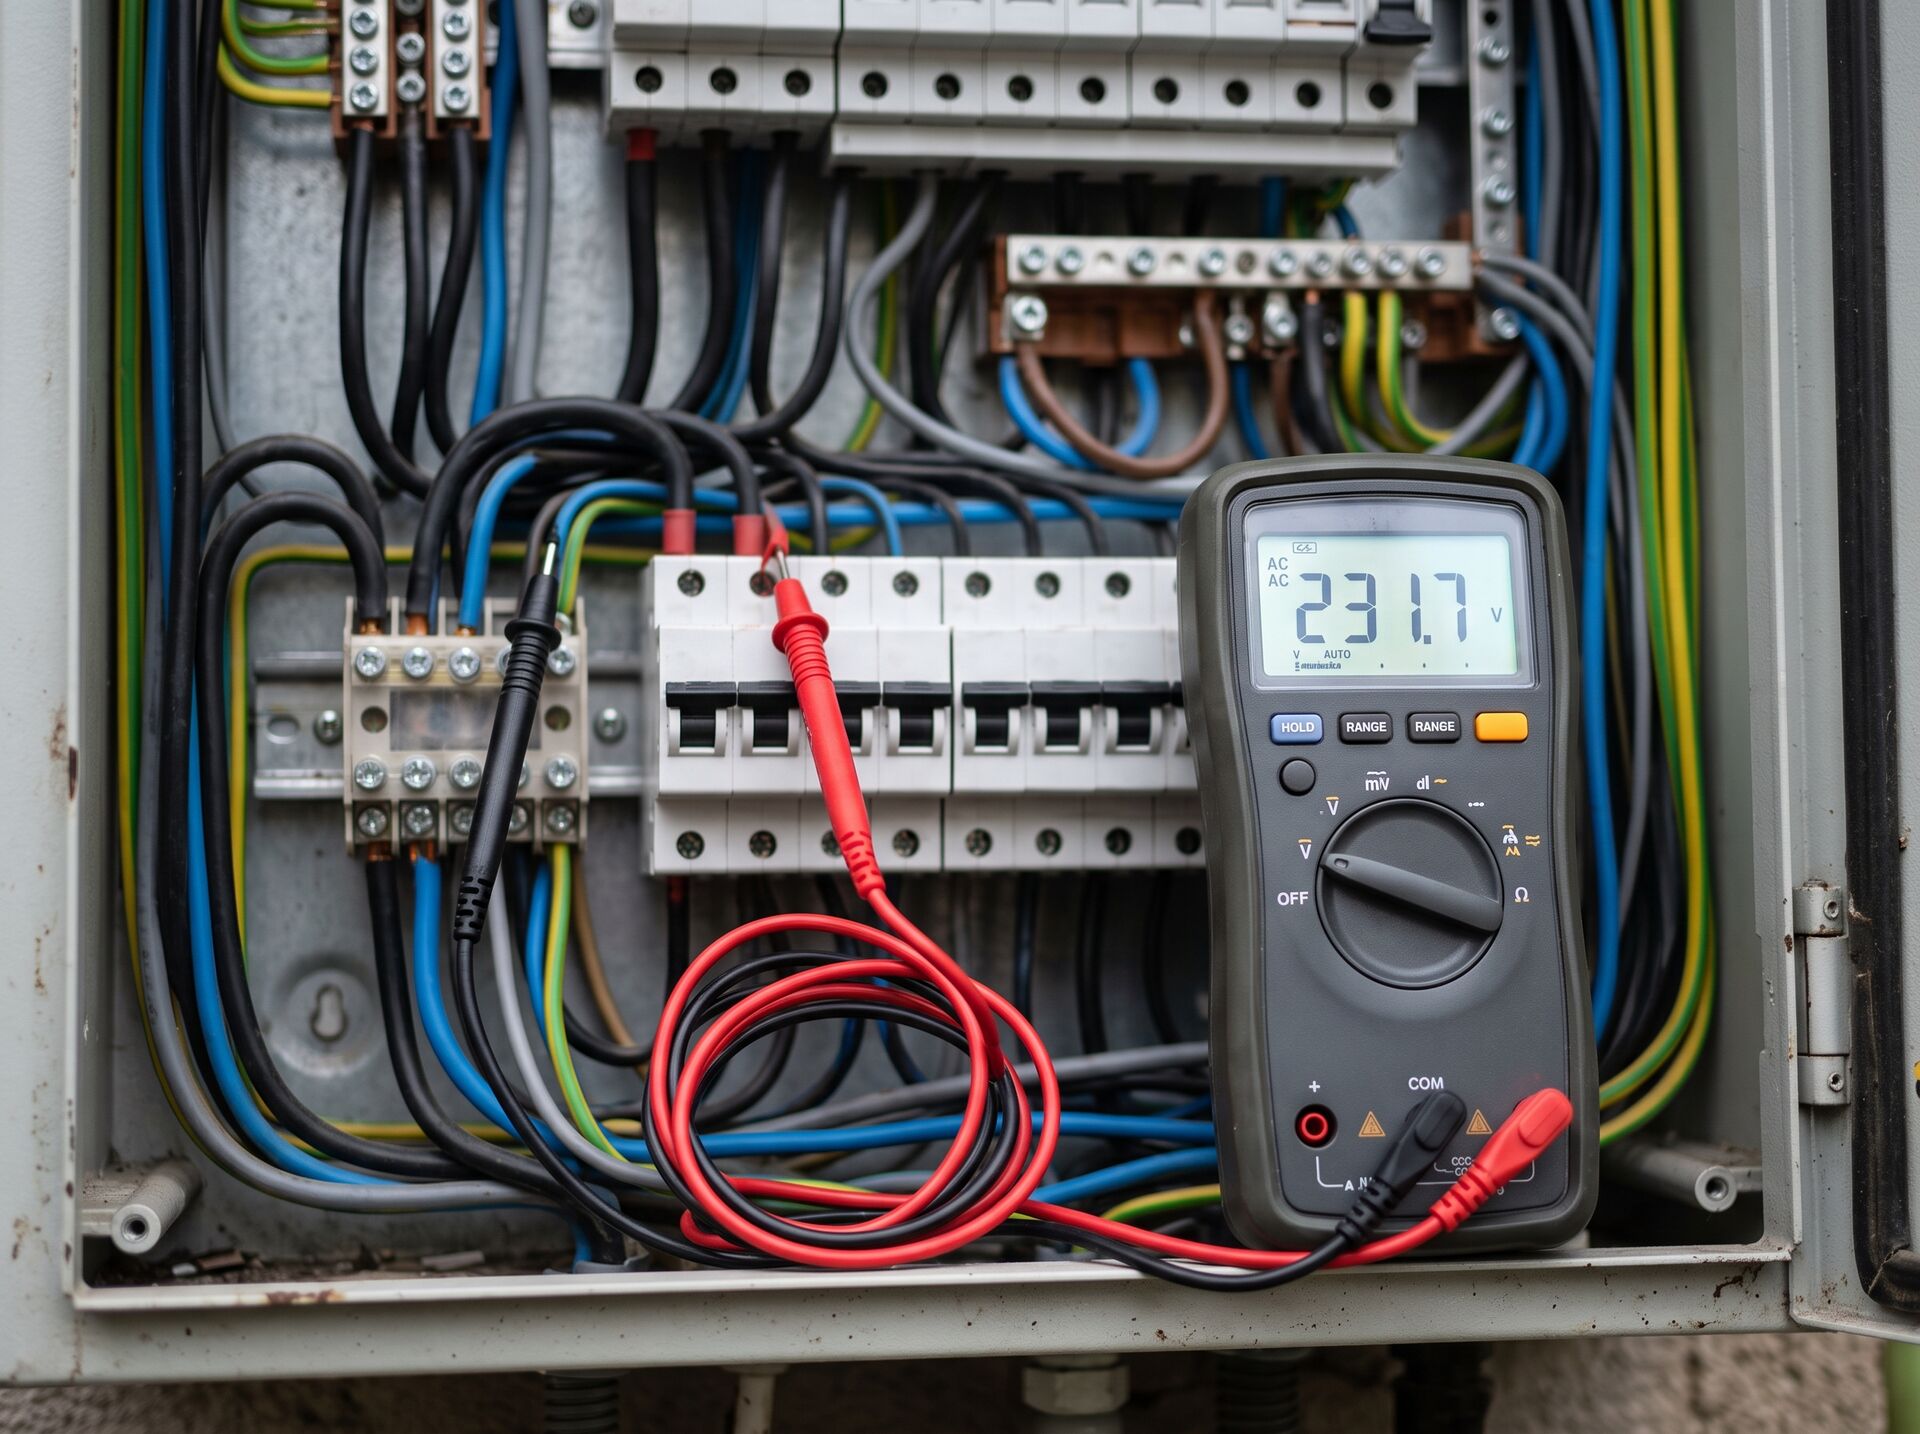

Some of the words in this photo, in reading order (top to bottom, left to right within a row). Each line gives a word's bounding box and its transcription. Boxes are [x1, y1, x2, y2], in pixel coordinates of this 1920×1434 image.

[1267, 556, 1289, 571] AC
[1268, 574, 1289, 587] AC
[1296, 572, 1467, 645] 231.7
[1490, 607, 1503, 623] V
[1293, 650, 1300, 659] V
[1324, 649, 1351, 659] AUTO
[1281, 722, 1315, 733] HOLD
[1346, 721, 1387, 733] RANGE
[1415, 721, 1455, 732] RANGE
[1277, 891, 1309, 906] OFF
[1408, 1076, 1444, 1091] COM
